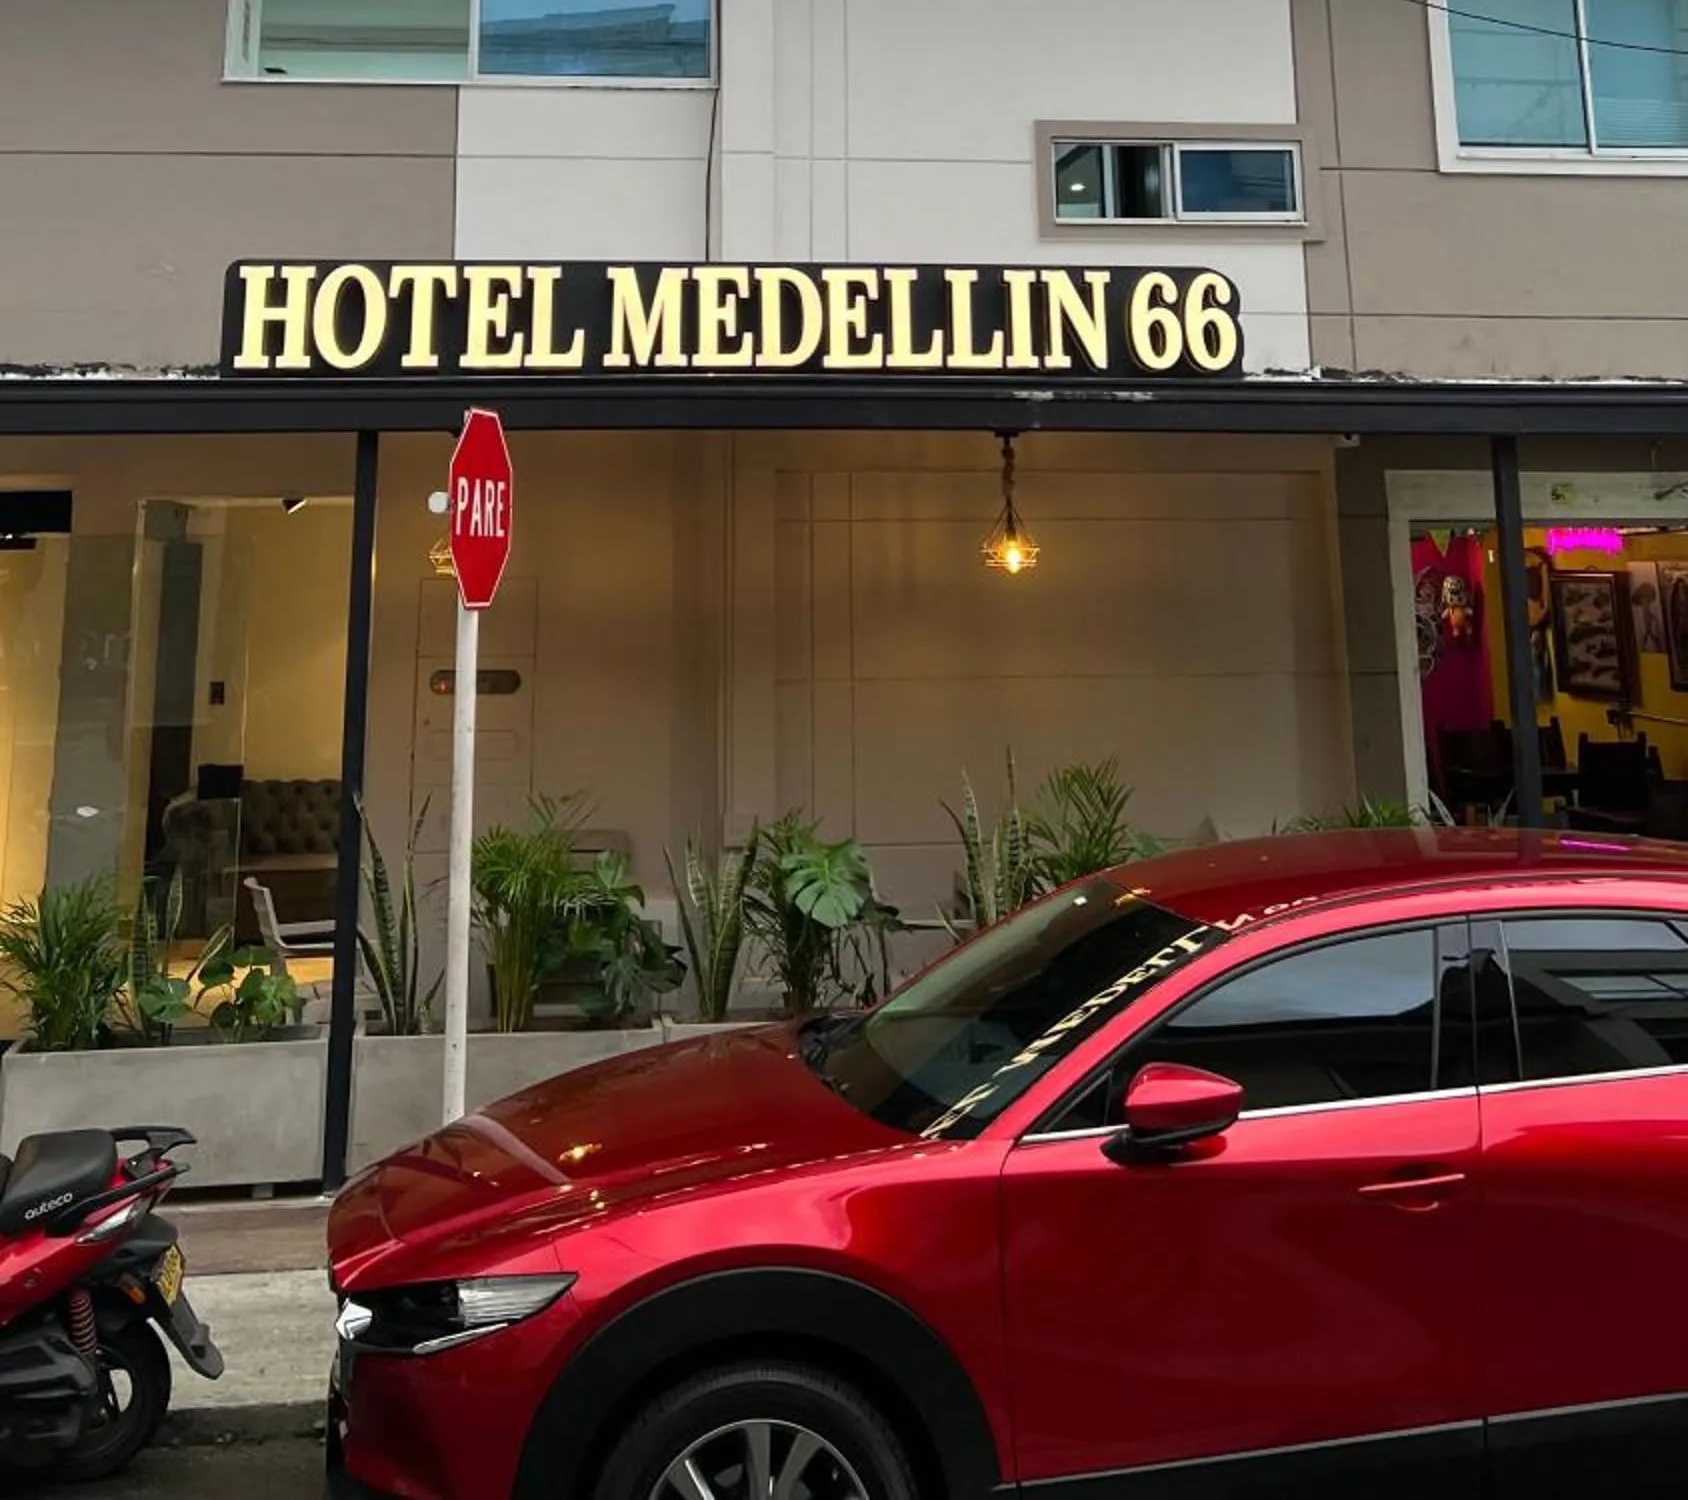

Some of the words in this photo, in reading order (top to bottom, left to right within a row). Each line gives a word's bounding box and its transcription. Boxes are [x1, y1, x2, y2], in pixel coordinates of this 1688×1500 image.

[233, 265, 585, 369] HOTEL
[603, 267, 1110, 371] MEDELLIN
[1130, 271, 1237, 371] 66
[455, 476, 506, 537] PARE
[24, 1192, 73, 1220] auteco
